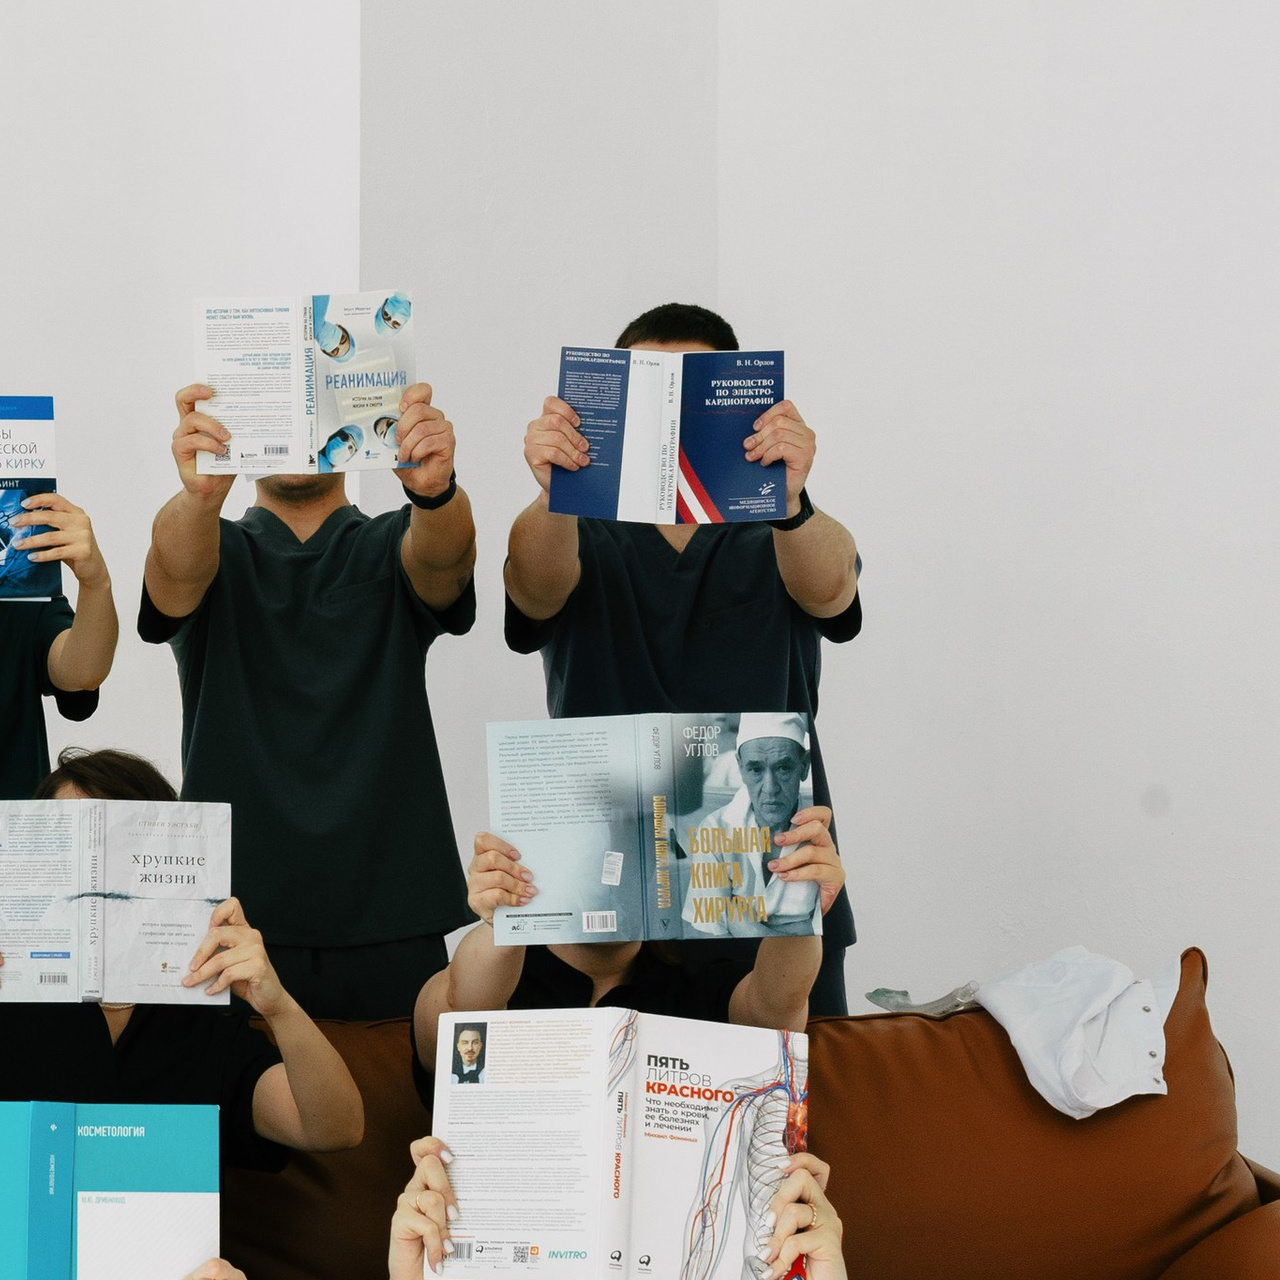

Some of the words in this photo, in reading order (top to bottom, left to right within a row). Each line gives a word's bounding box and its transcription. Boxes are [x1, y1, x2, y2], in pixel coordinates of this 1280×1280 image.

[305, 347, 315, 415] РЕАНИМАЦИЯ
[325, 370, 407, 390] РЕАНИМАЦИЯ
[711, 379, 774, 387] РУКОВОДСТВО
[732, 388, 774, 396] ЭЛЕКТРО-
[705, 398, 774, 406] КАРДИОГРАФИИ
[662, 444, 667, 454] ПО
[6, 459, 46, 470] КИРКУ
[667, 420, 676, 511] ЭЛЕКТРОКАРДИОГРАФИИ
[659, 457, 667, 511] РУКОВОДСТВО
[683, 726, 721, 741] ФЕДОР
[684, 743, 720, 757] УГЛОВ
[653, 795, 667, 837] БОЛЬШАЯ
[688, 827, 772, 854] БОЛЬШАЯ
[132, 854, 205, 868] хрупкие
[655, 838, 668, 867] КНИГА
[90, 855, 98, 892] жизни
[139, 873, 196, 884] жизни
[691, 862, 743, 889] КНИГА
[656, 869, 671, 909] ХИРУРГА
[693, 896, 768, 924] ХИРУРГА
[89, 899, 100, 945] хрупкие
[647, 1054, 690, 1071] ПЯТЬ
[646, 1068, 712, 1087] ЛИТРОВ
[646, 1081, 734, 1103] КРАСНОГО
[645, 1097, 661, 1105] Что
[664, 1099, 718, 1112] необходимо
[645, 1106, 670, 1114] знать
[681, 1110, 710, 1120] крови,
[654, 1122, 692, 1132] лечении
[659, 1114, 700, 1125] болезнях
[77, 1126, 145, 1137] КОСМЕТОЛОГИЯ
[615, 1116, 623, 1151] ЛИТРОВ
[613, 1152, 621, 1199] КРАСНОГО
[548, 1251, 588, 1259] INVITRO
